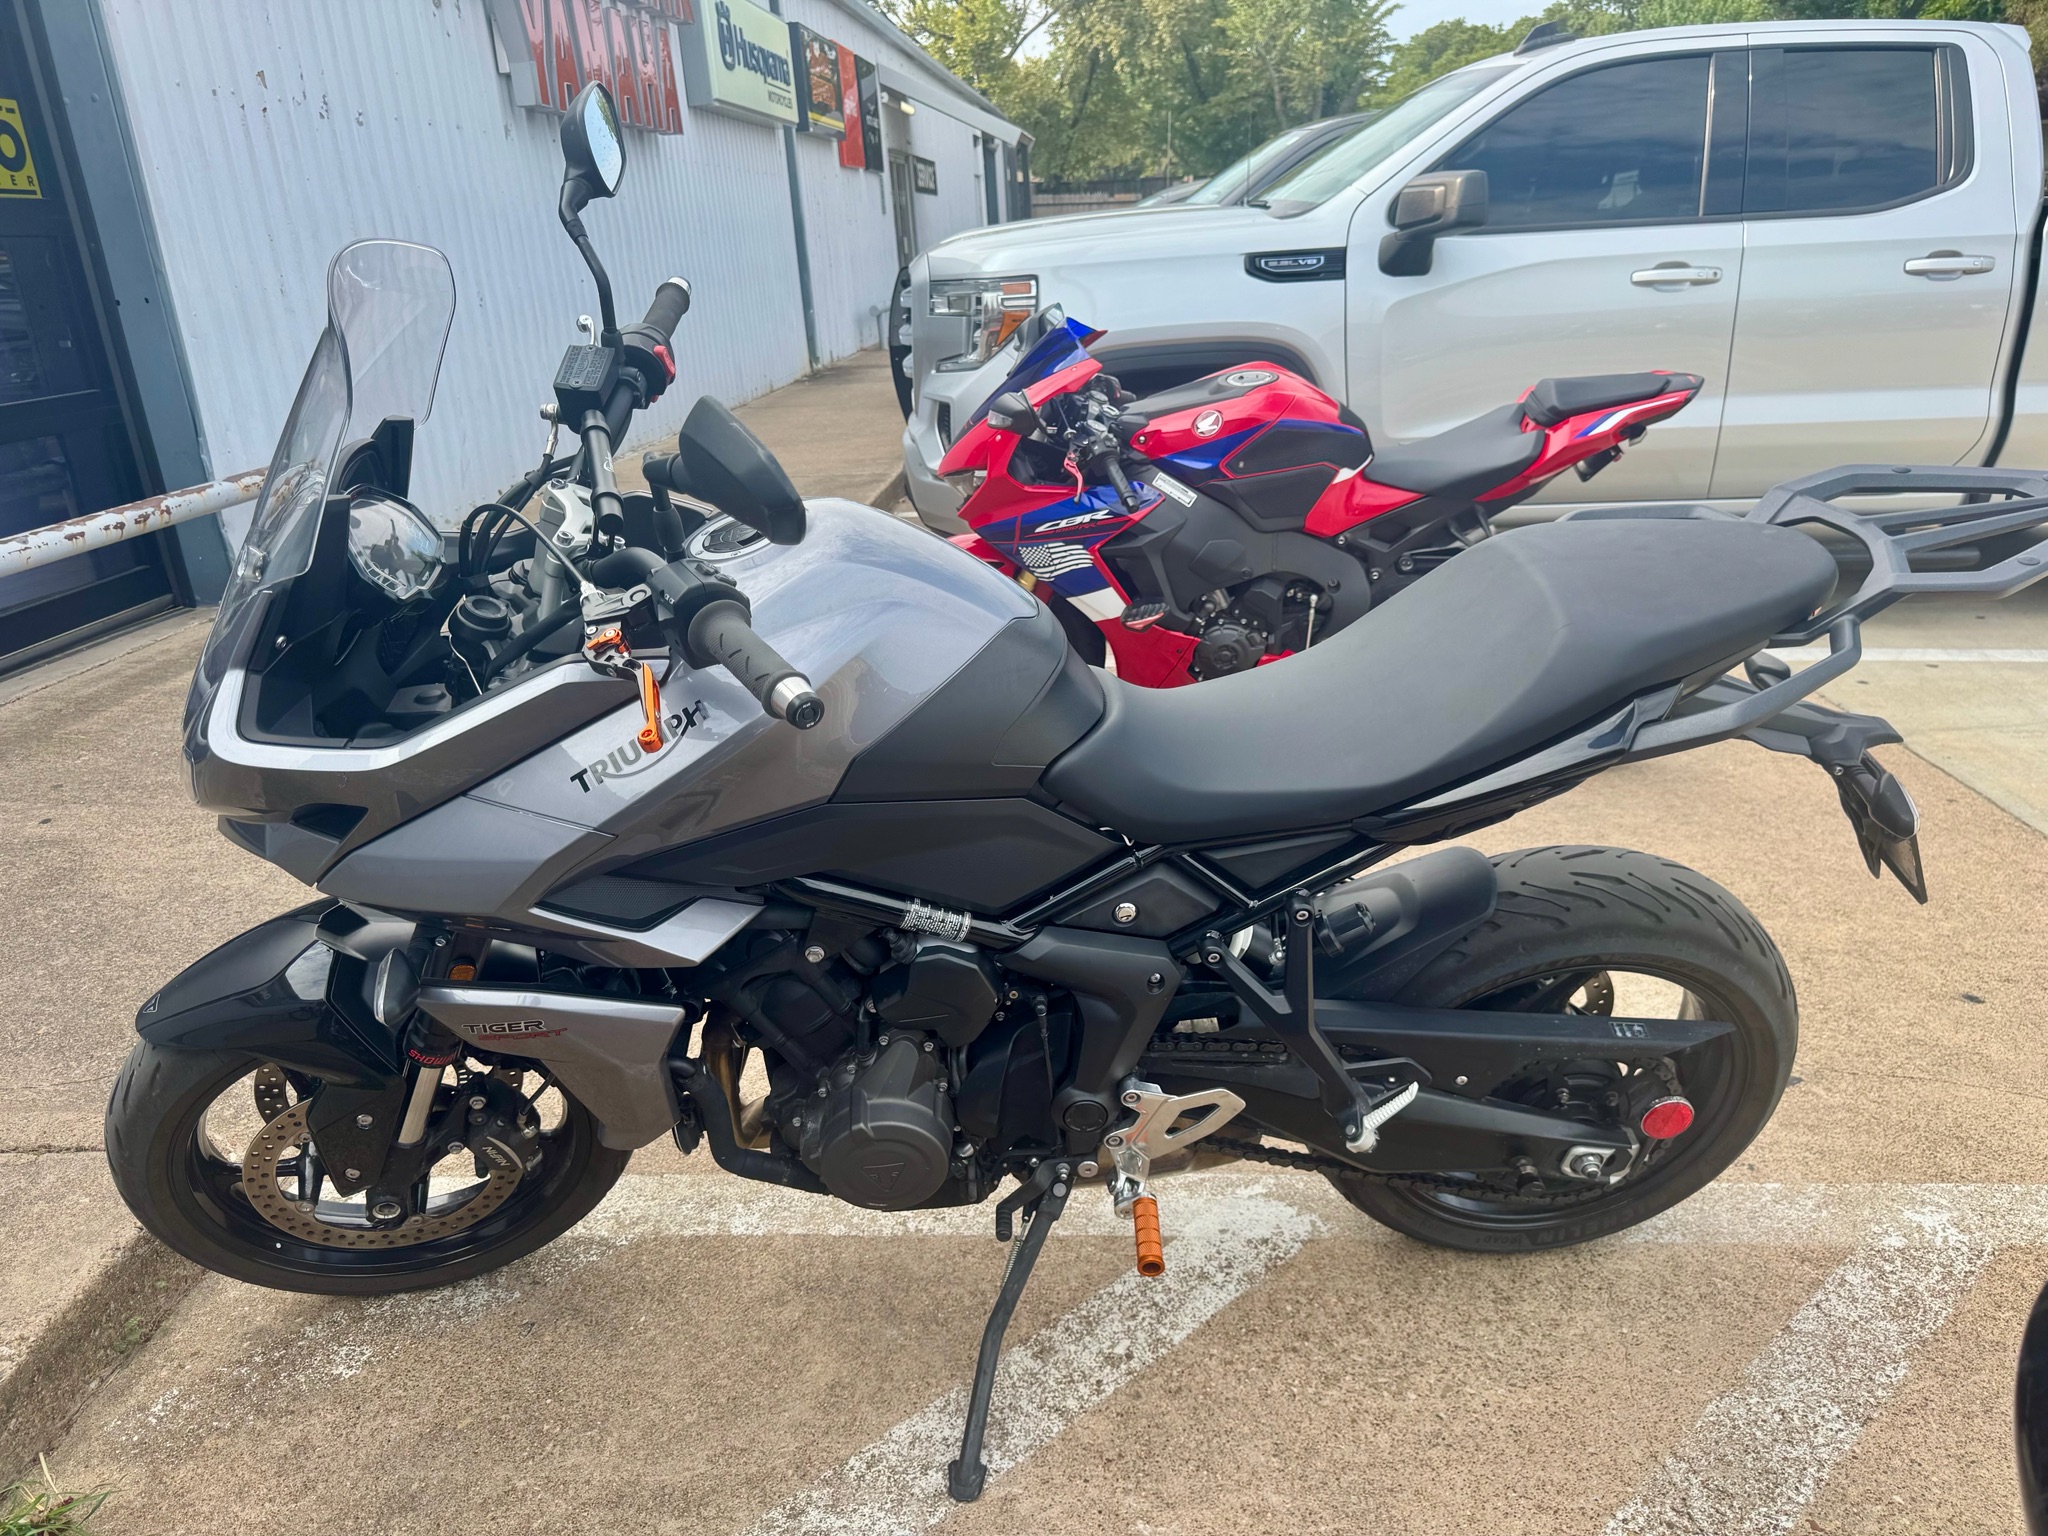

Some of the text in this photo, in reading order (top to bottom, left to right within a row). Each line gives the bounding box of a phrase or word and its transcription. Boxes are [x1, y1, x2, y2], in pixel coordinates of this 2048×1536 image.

[1034, 509, 1114, 533] CBR
[461, 1019, 548, 1035] TIGER
[477, 1027, 568, 1041] SPORT
[408, 1049, 457, 1065] SHOWA
